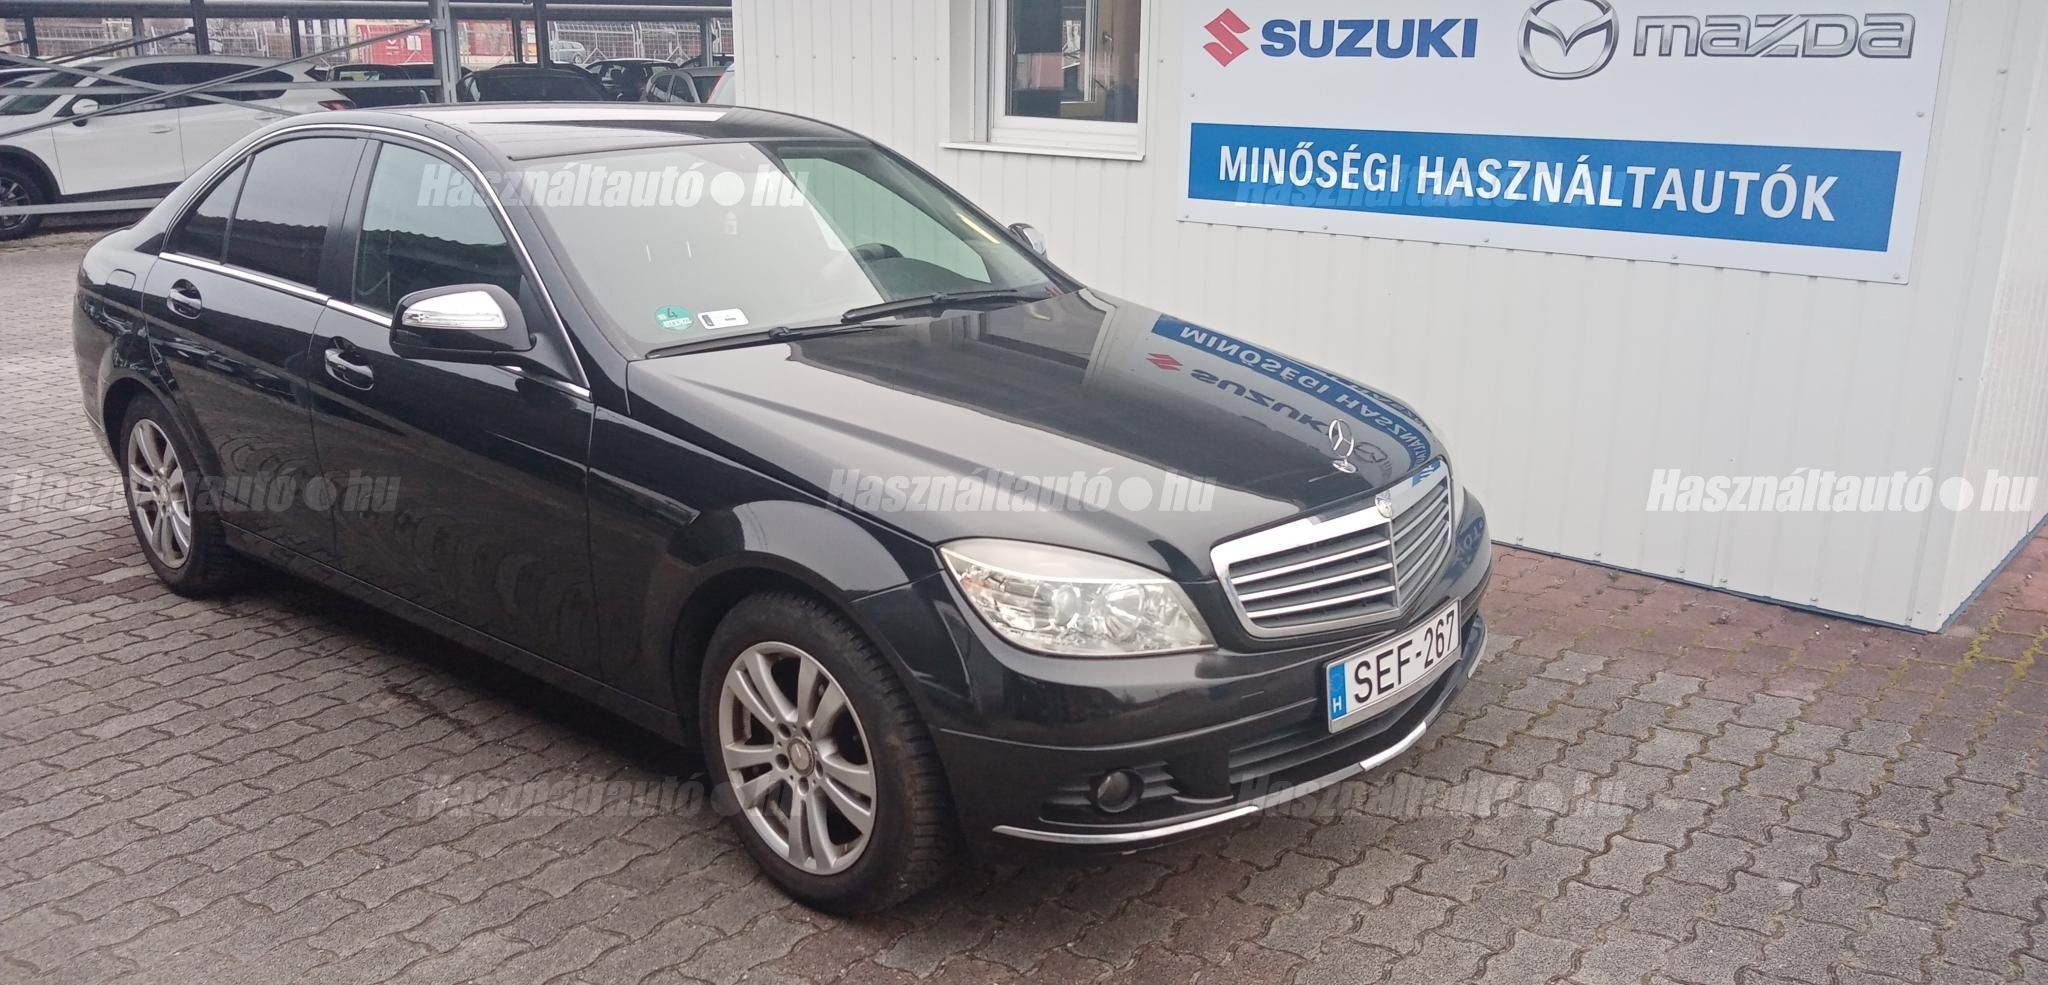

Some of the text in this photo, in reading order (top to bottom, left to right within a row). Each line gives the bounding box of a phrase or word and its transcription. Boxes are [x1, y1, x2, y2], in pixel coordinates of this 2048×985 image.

[1260, 18, 1478, 60] SUZUKI
[1218, 141, 1837, 223] MINŐSÉGI HASZNÁLTAUTÓK
[1332, 609, 1455, 713] H SEF-267
